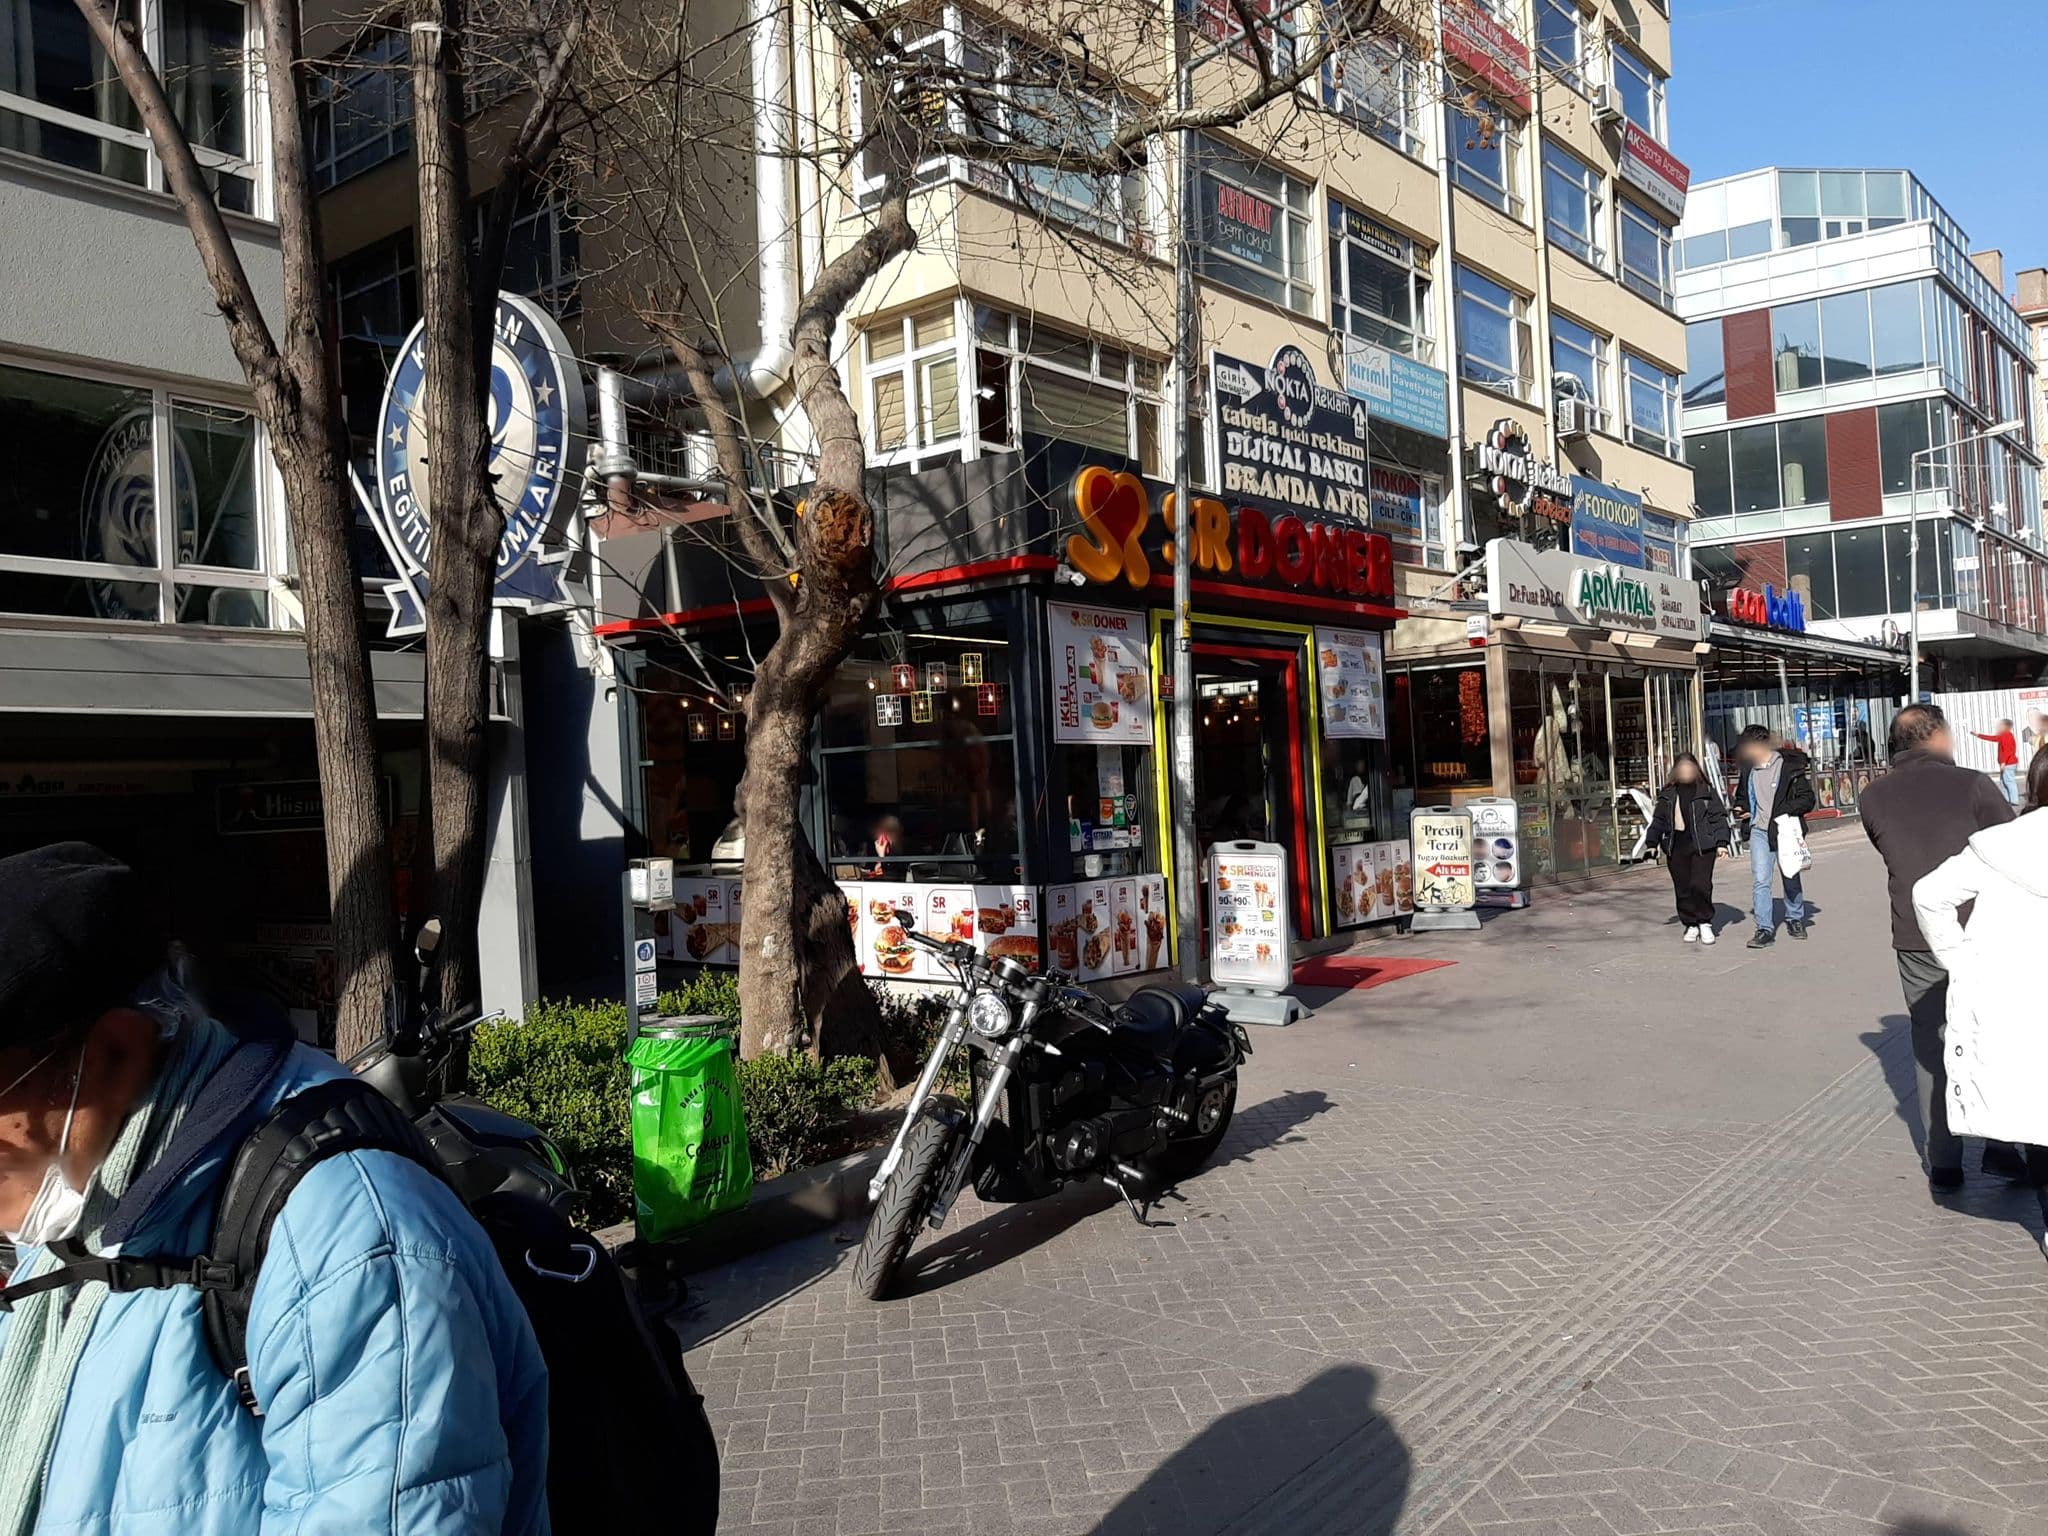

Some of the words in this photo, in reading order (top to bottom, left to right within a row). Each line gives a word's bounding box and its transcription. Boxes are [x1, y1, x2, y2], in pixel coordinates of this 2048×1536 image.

[1218, 183, 1272, 235] AVUKAT
[1264, 368, 1309, 403] NOKTA
[1314, 386, 1351, 416] Reklam
[1392, 374, 1444, 401] Davetiyeleri
[1221, 404, 1279, 437] tabela
[1311, 433, 1365, 462] reklam
[1226, 431, 1306, 473] DİJİTAL
[1308, 452, 1364, 488] BASKI
[1224, 461, 1321, 510] BRANDA
[1585, 492, 1640, 529] FOTOKOPİ
[1421, 825, 1463, 839] Prestij
[1427, 839, 1459, 851] Terzi
[708, 890, 718, 900] SR
[902, 896, 913, 907] SR
[933, 896, 946, 908] SR
[1016, 899, 1030, 911] SR
